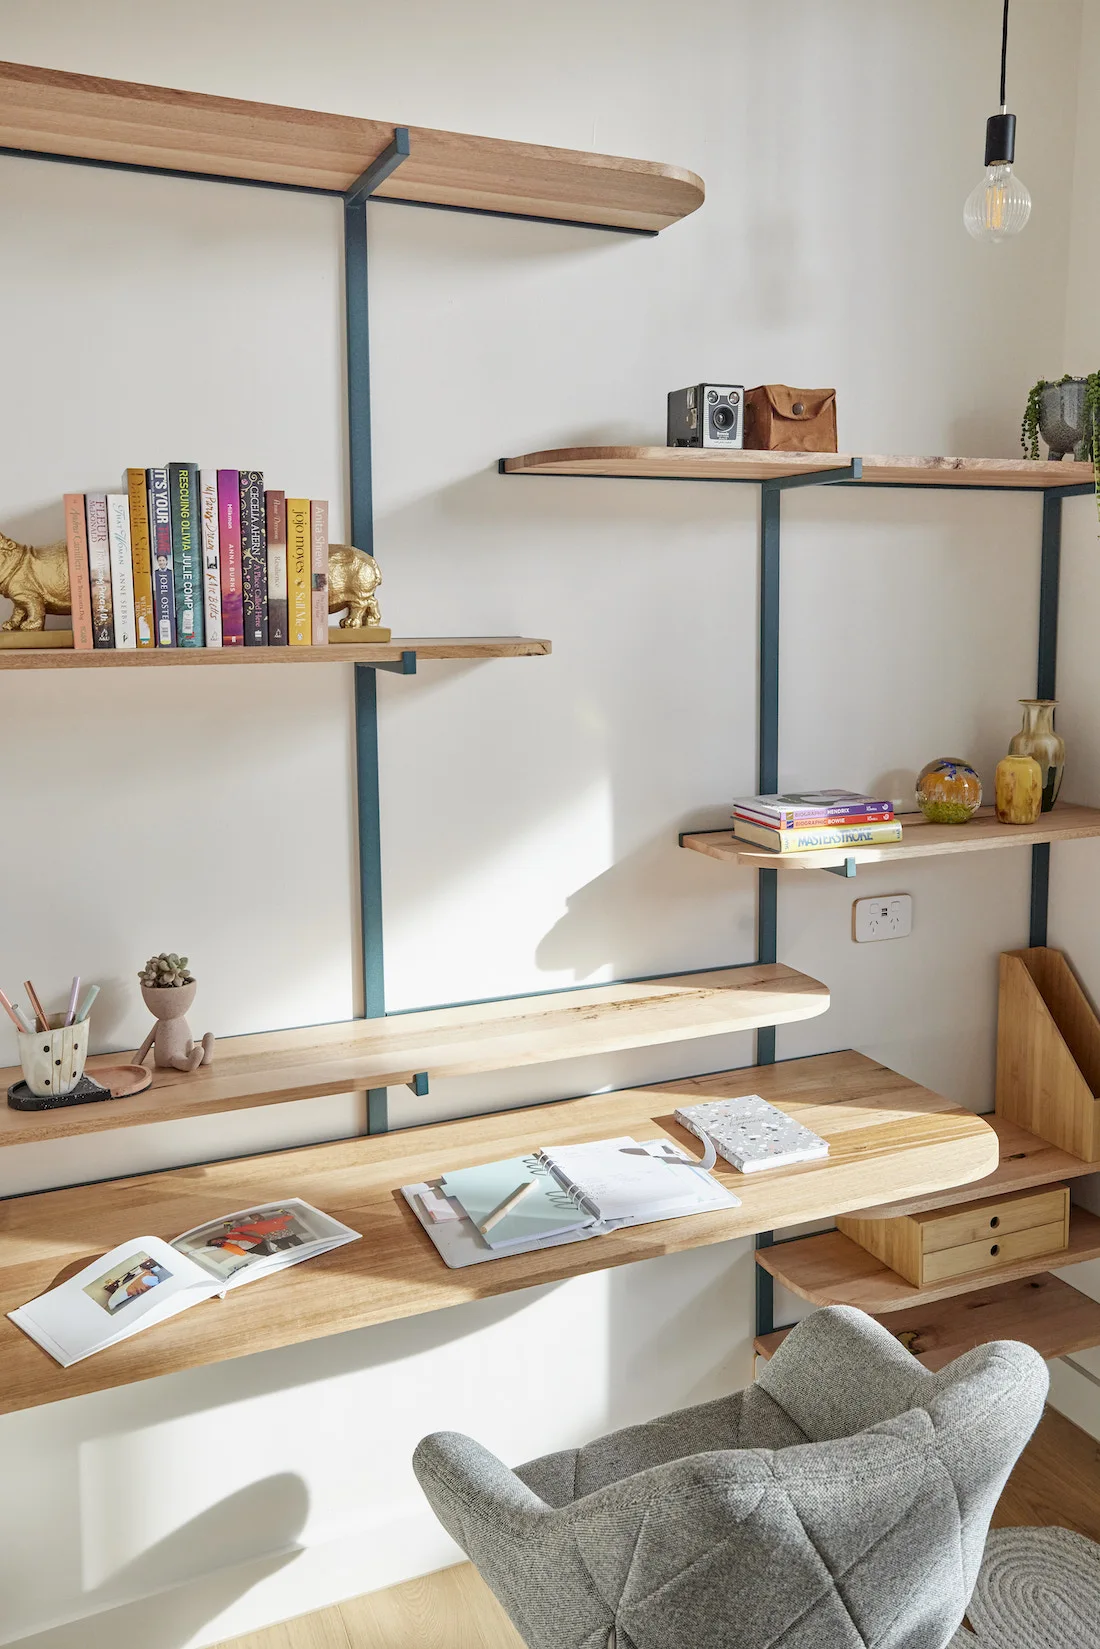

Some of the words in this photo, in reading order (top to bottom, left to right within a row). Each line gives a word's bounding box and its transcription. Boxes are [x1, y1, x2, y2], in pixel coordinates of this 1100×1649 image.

[154, 468, 169, 490] IT'S
[130, 472, 147, 528] Danielle
[179, 469, 191, 518] RESCUING
[249, 486, 259, 524] CECELIA
[96, 500, 107, 542] FLEUR
[155, 492, 169, 524] YOUR
[204, 496, 216, 522] Paris
[292, 509, 307, 534] jojo
[315, 506, 324, 533] Anita
[157, 526, 170, 552] TIME
[180, 520, 191, 551] OLIVIA
[205, 522, 217, 551] Dream
[251, 524, 261, 556] AHERN
[73, 535, 84, 570] Camilleri
[133, 536, 149, 574] Steel
[292, 536, 305, 574] moyes
[314, 536, 326, 568] Shreve
[182, 552, 193, 580] JULIE
[159, 574, 170, 594] JOEL
[254, 572, 262, 588] Place
[161, 596, 170, 620] OSTE
[183, 581, 194, 611] COMP
[295, 592, 306, 608] Still
[120, 600, 128, 625] SEBBA
[296, 610, 306, 626] Me
[795, 810, 826, 818] BIOGRAPHIC
[827, 808, 850, 816] HENDRIX
[795, 818, 826, 827] BIOGRAPHIC
[828, 817, 846, 825] BOWIE
[798, 831, 874, 848] MASTERSTROKE
